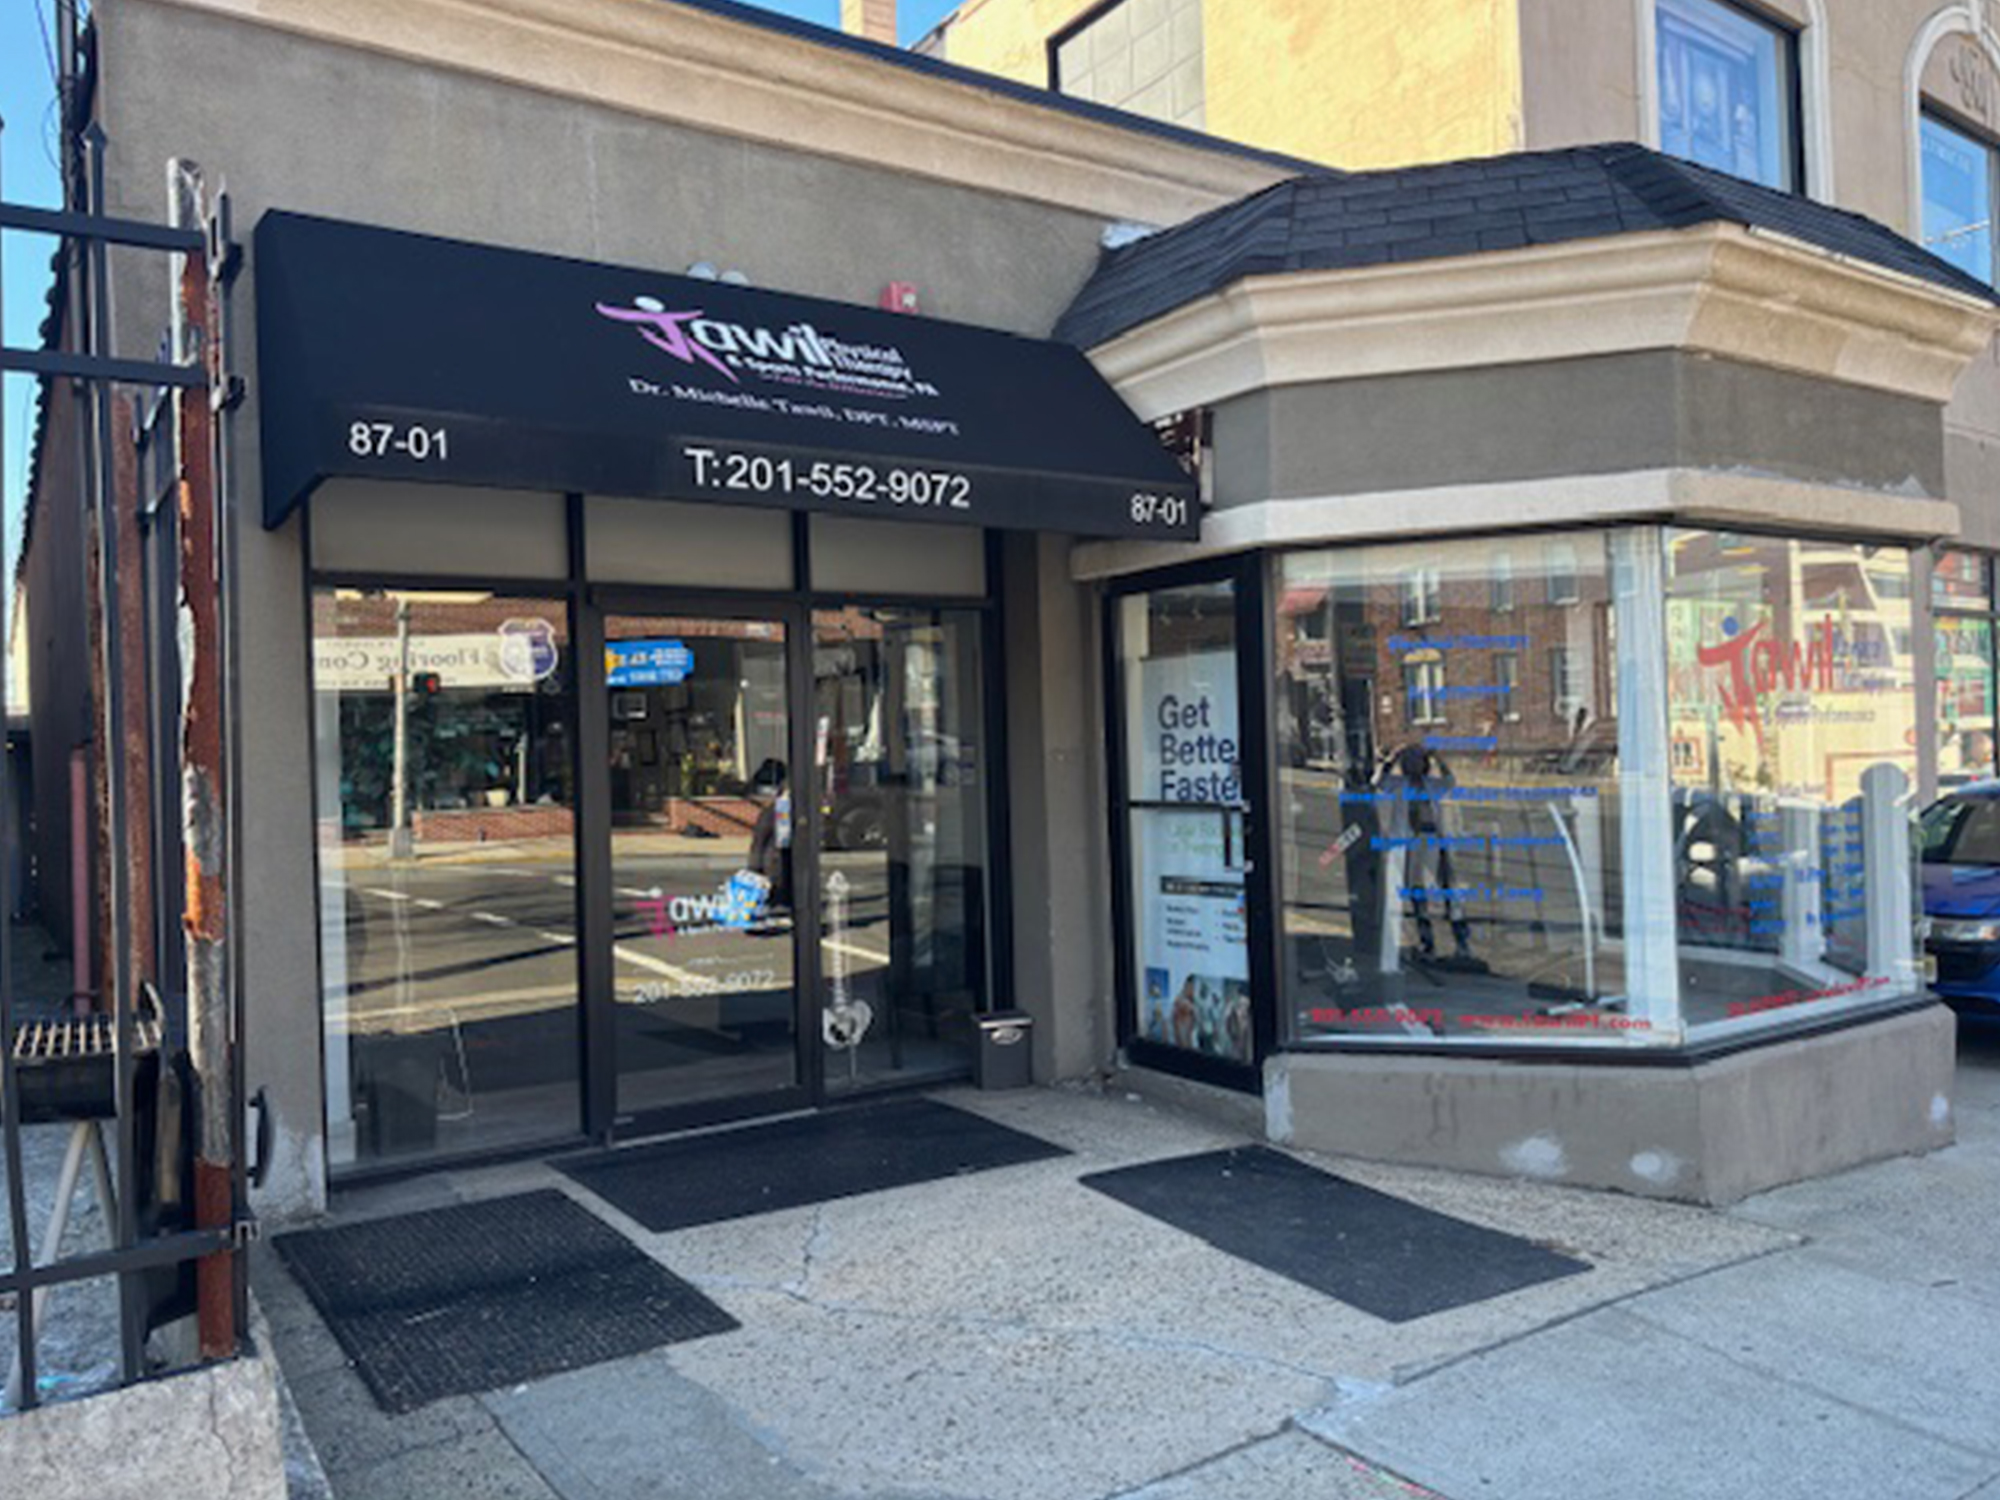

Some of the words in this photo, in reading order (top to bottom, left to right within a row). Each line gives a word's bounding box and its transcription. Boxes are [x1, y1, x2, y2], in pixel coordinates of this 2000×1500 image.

[629, 378, 669, 396] Dr.
[350, 421, 448, 460] 87-01
[685, 447, 971, 508] T:201-552-9072
[1131, 493, 1187, 526] 87-01
[1158, 694, 1210, 730] Get
